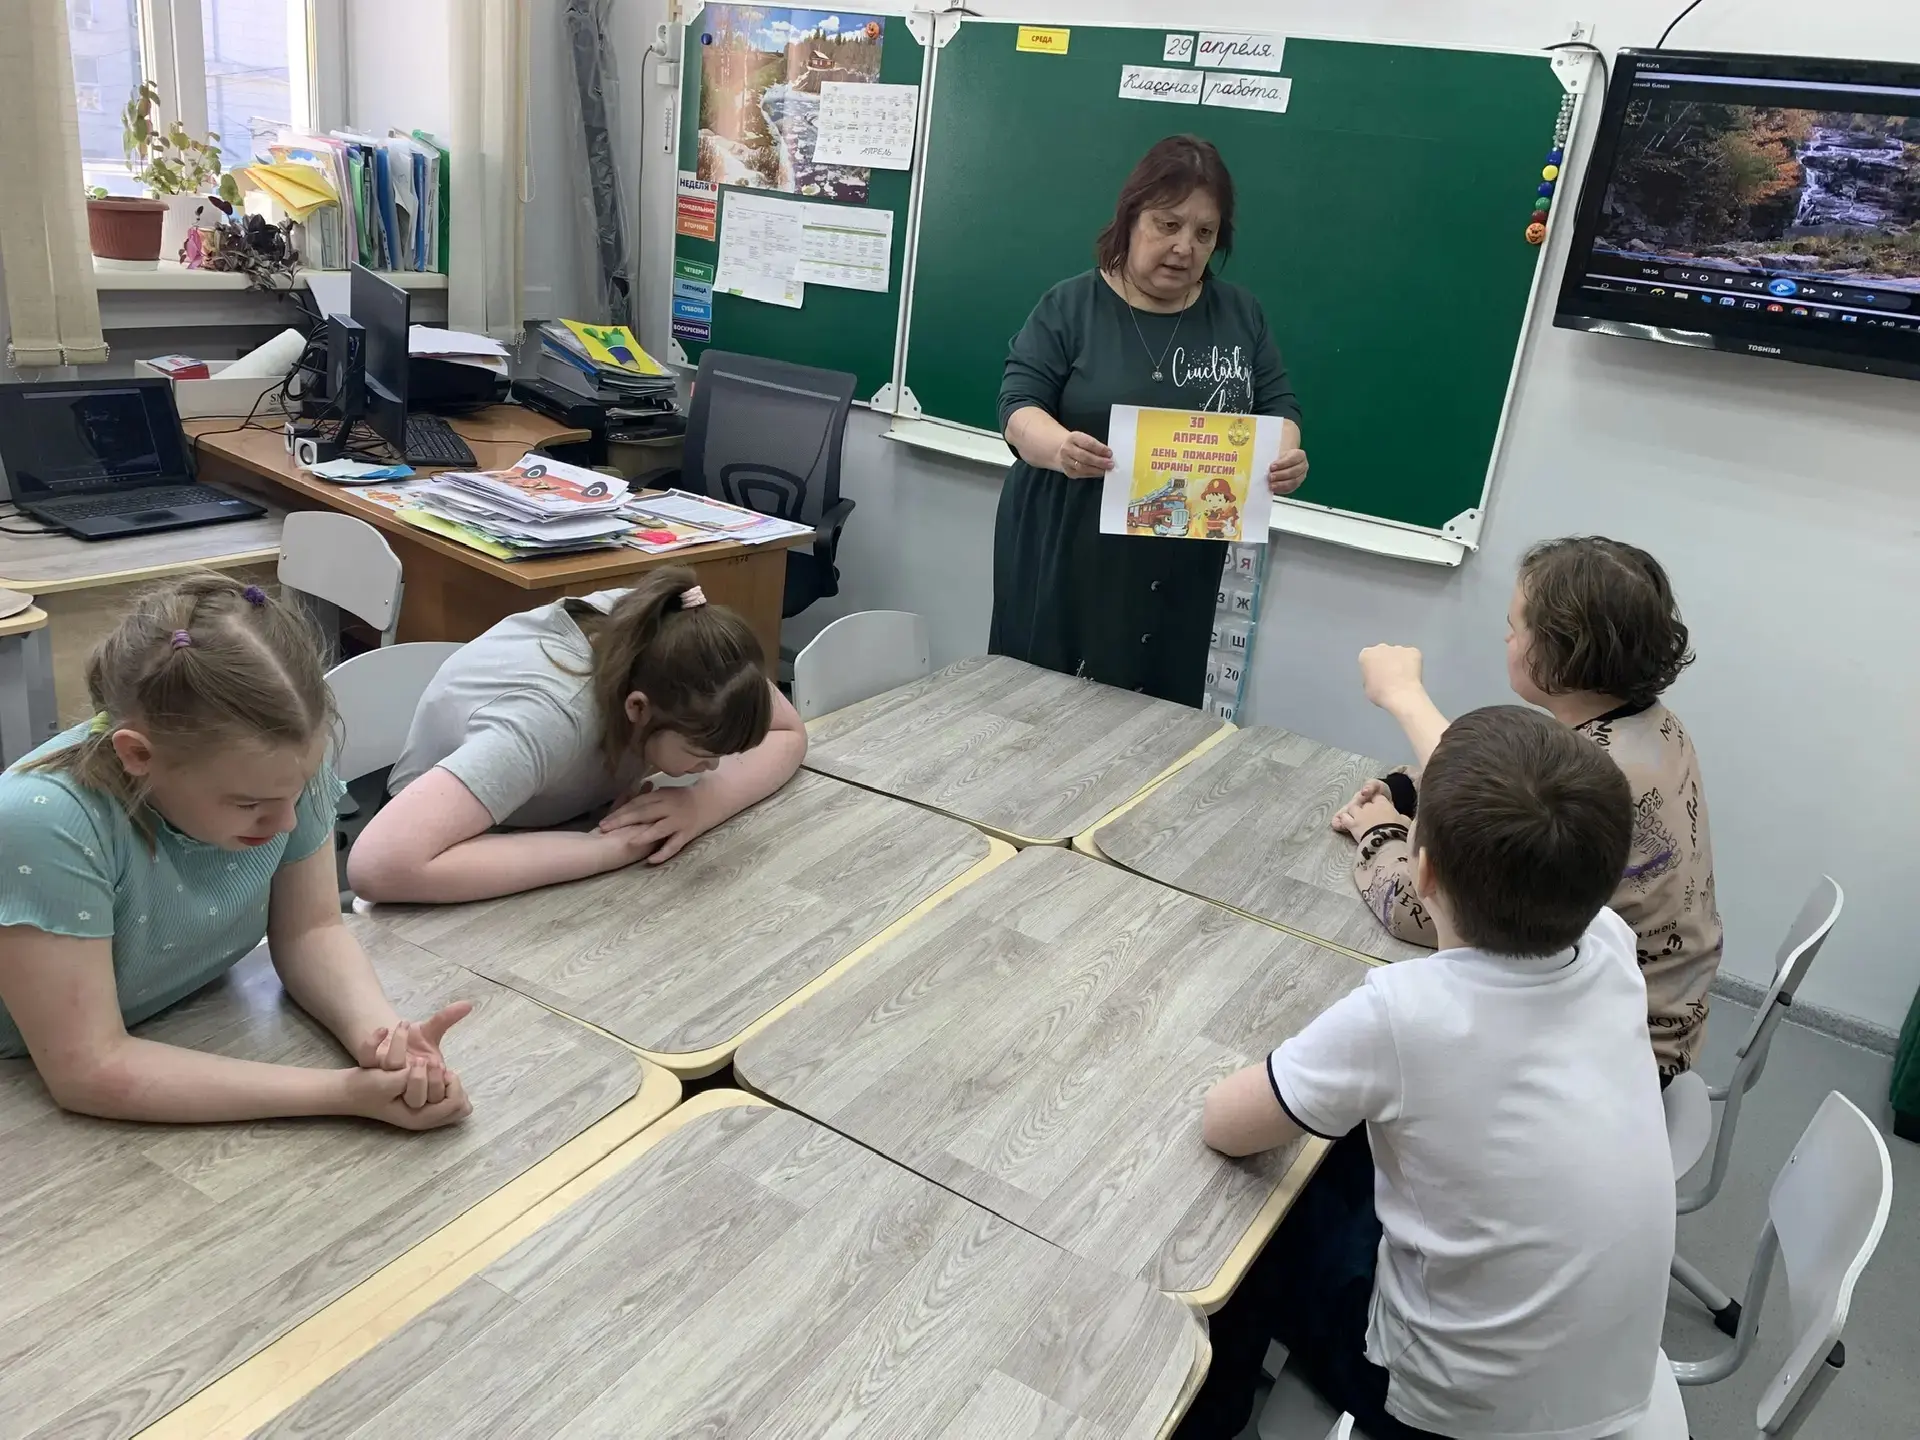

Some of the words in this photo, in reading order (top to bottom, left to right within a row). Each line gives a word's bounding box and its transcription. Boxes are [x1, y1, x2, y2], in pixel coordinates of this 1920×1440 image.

[1031, 35, 1052, 44] СРЕДА
[1166, 38, 1192, 56] 29
[1123, 73, 1199, 94] Классная
[860, 147, 892, 157] АПРЕЛЬ
[679, 178, 710, 191] НЕДЕЛЯ
[678, 202, 716, 214] ПОНЕДЕЛЬНИК
[684, 221, 709, 231] ВТОРНИК
[683, 266, 704, 276] ЧЕТВЕРГ
[682, 283, 707, 294] ПЯТНИЦА
[681, 305, 705, 314] СУББОТА
[673, 324, 709, 336] ВОСКРЕСЕНЬЕ
[1747, 344, 1781, 354] TOSHIBA
[1189, 416, 1205, 429] 30
[1172, 431, 1219, 445] АПРЕЛЯ
[1150, 447, 1178, 459] ДЕНЬ
[1182, 450, 1238, 463] ПОЖАРНОЙ
[1150, 461, 1193, 473] ОХРАНЫ
[1197, 464, 1236, 476] РОССИИ
[1240, 557, 1251, 570] Я
[1236, 596, 1251, 611] Ж
[1232, 635, 1246, 648] Ш
[1224, 667, 1240, 682] 20
[1220, 706, 1232, 720] 10
